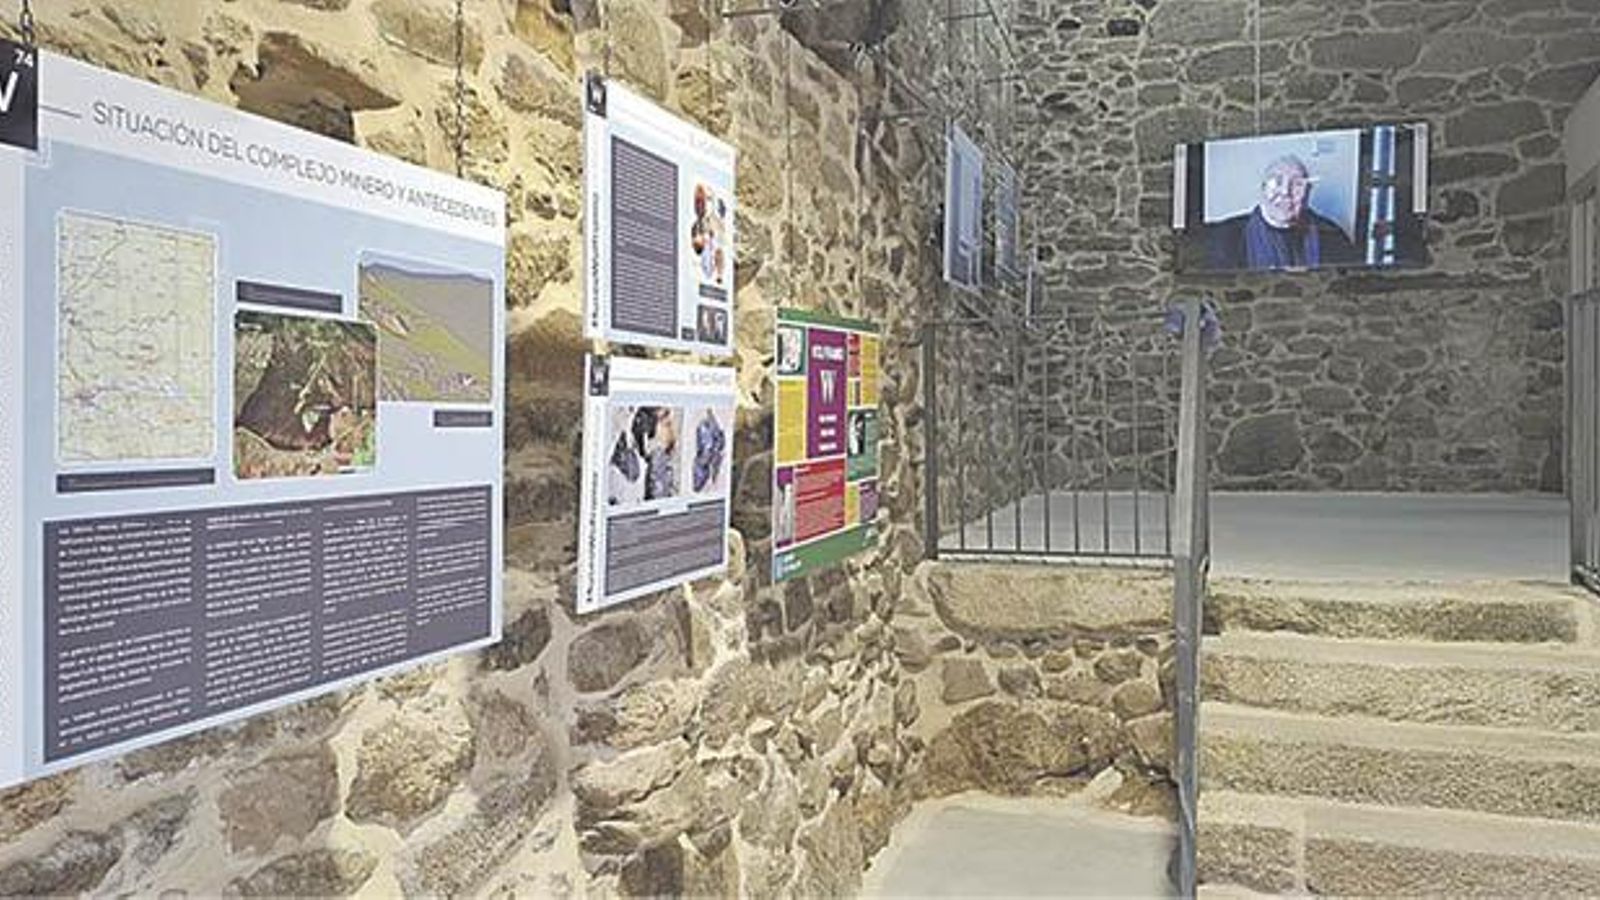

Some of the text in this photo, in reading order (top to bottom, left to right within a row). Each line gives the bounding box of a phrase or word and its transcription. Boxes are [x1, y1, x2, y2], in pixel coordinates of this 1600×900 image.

[208, 132, 243, 161] DEL
[249, 143, 338, 185] COMPLEJO
[340, 169, 395, 200] MINERO
[395, 185, 407, 203] Y
[407, 187, 497, 227] ANTECEDENTES
